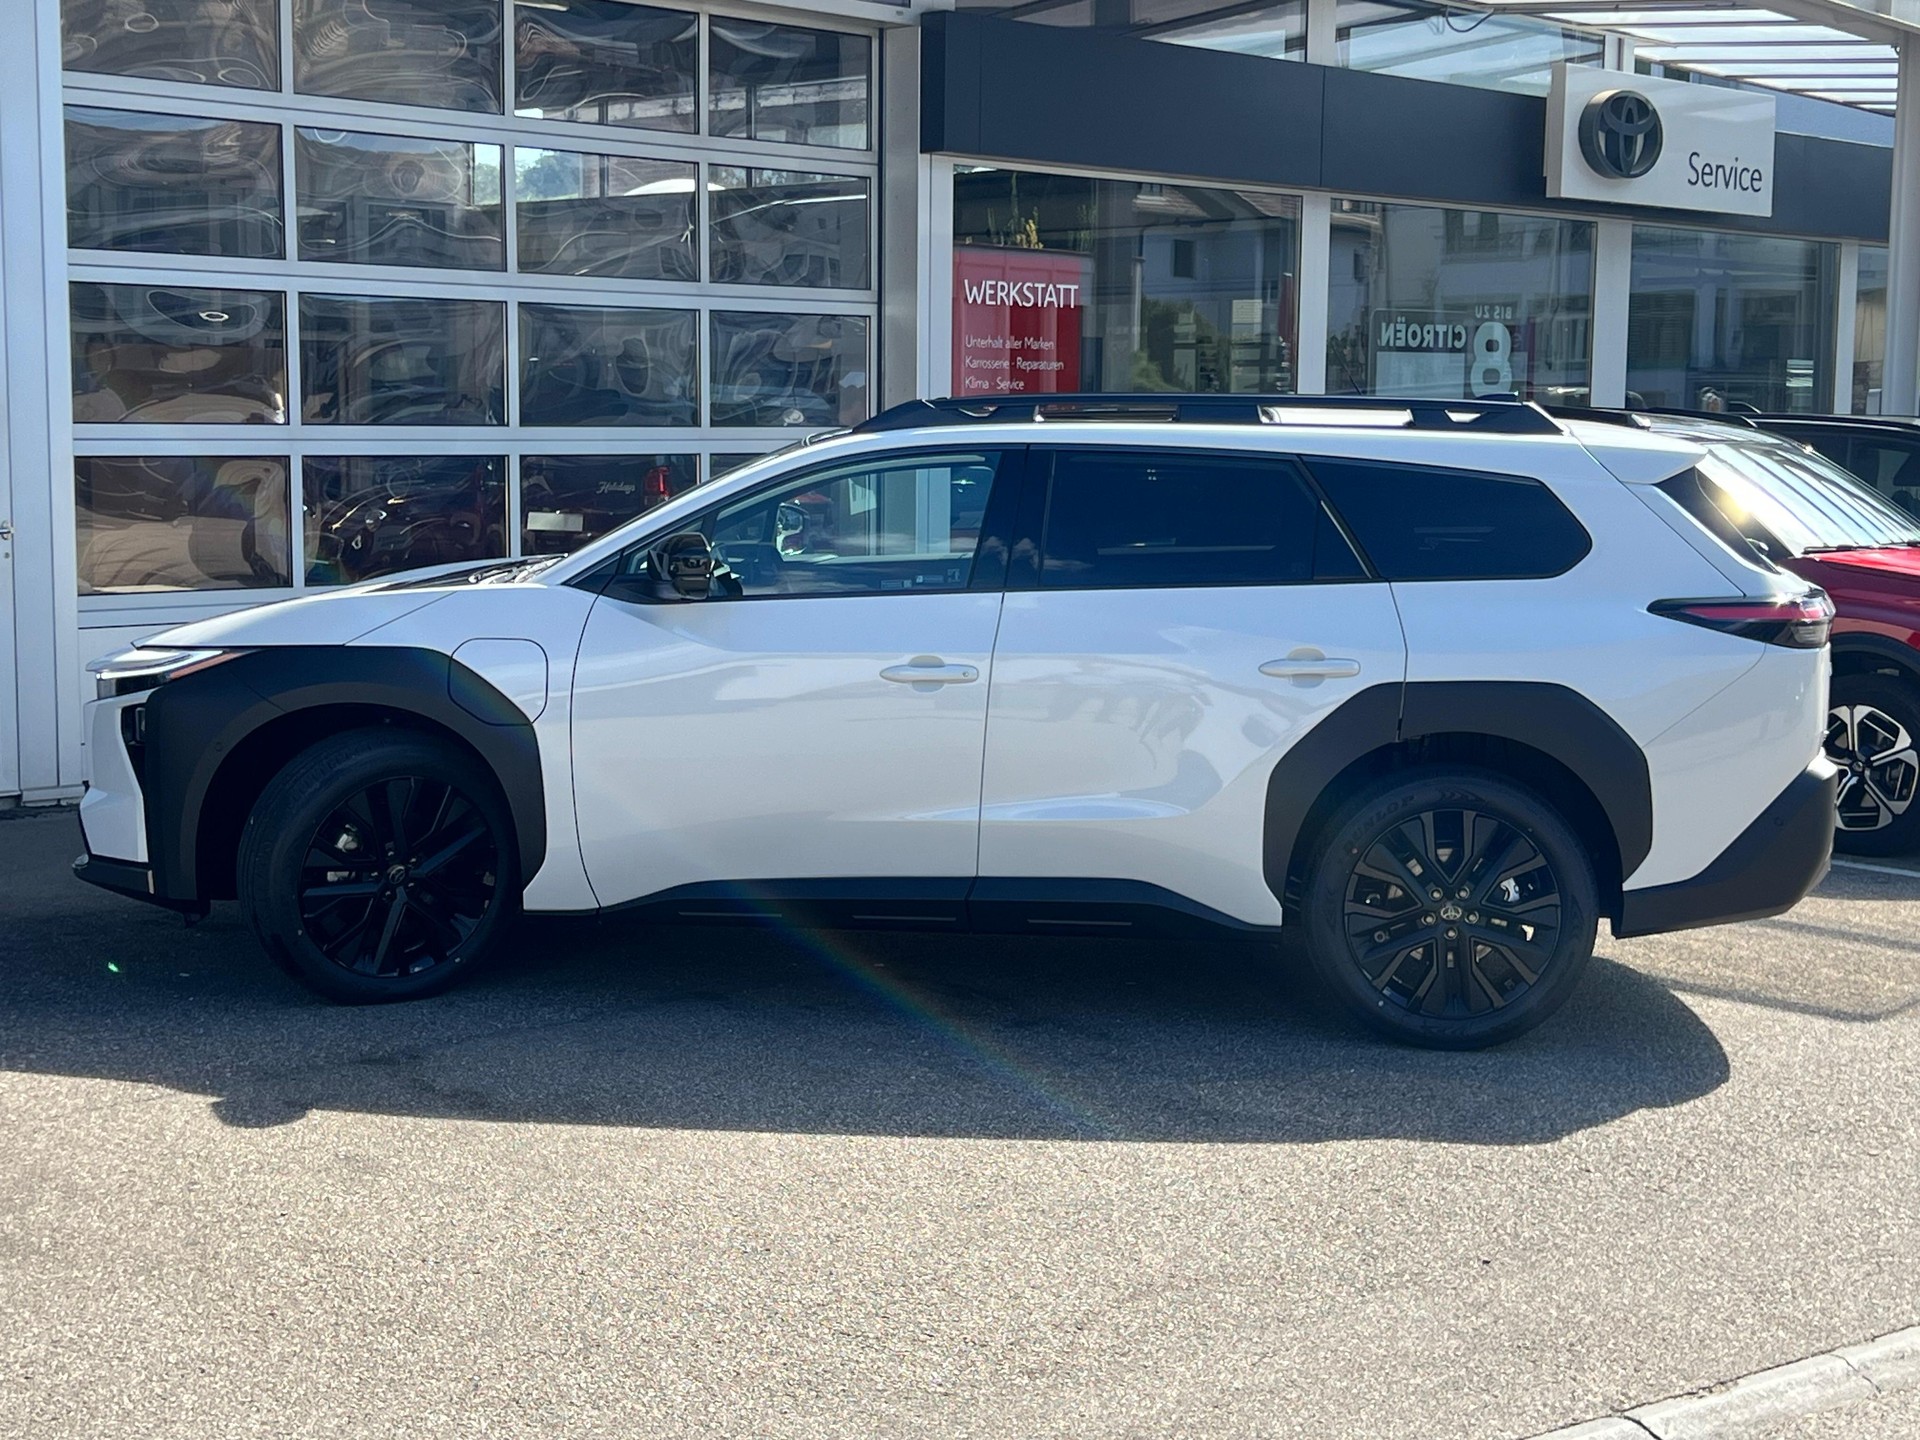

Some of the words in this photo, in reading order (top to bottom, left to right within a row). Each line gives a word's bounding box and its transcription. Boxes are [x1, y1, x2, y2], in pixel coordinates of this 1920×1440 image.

[1688, 152, 1762, 193] Service
[964, 278, 1079, 309] WERKSTATT
[965, 335, 1003, 349] Unterhalt
[1005, 336, 1023, 349] aller
[1024, 337, 1055, 350] Marken
[1016, 357, 1065, 373] Reparaturen
[965, 377, 990, 390] Klima
[996, 376, 1025, 390] Service
